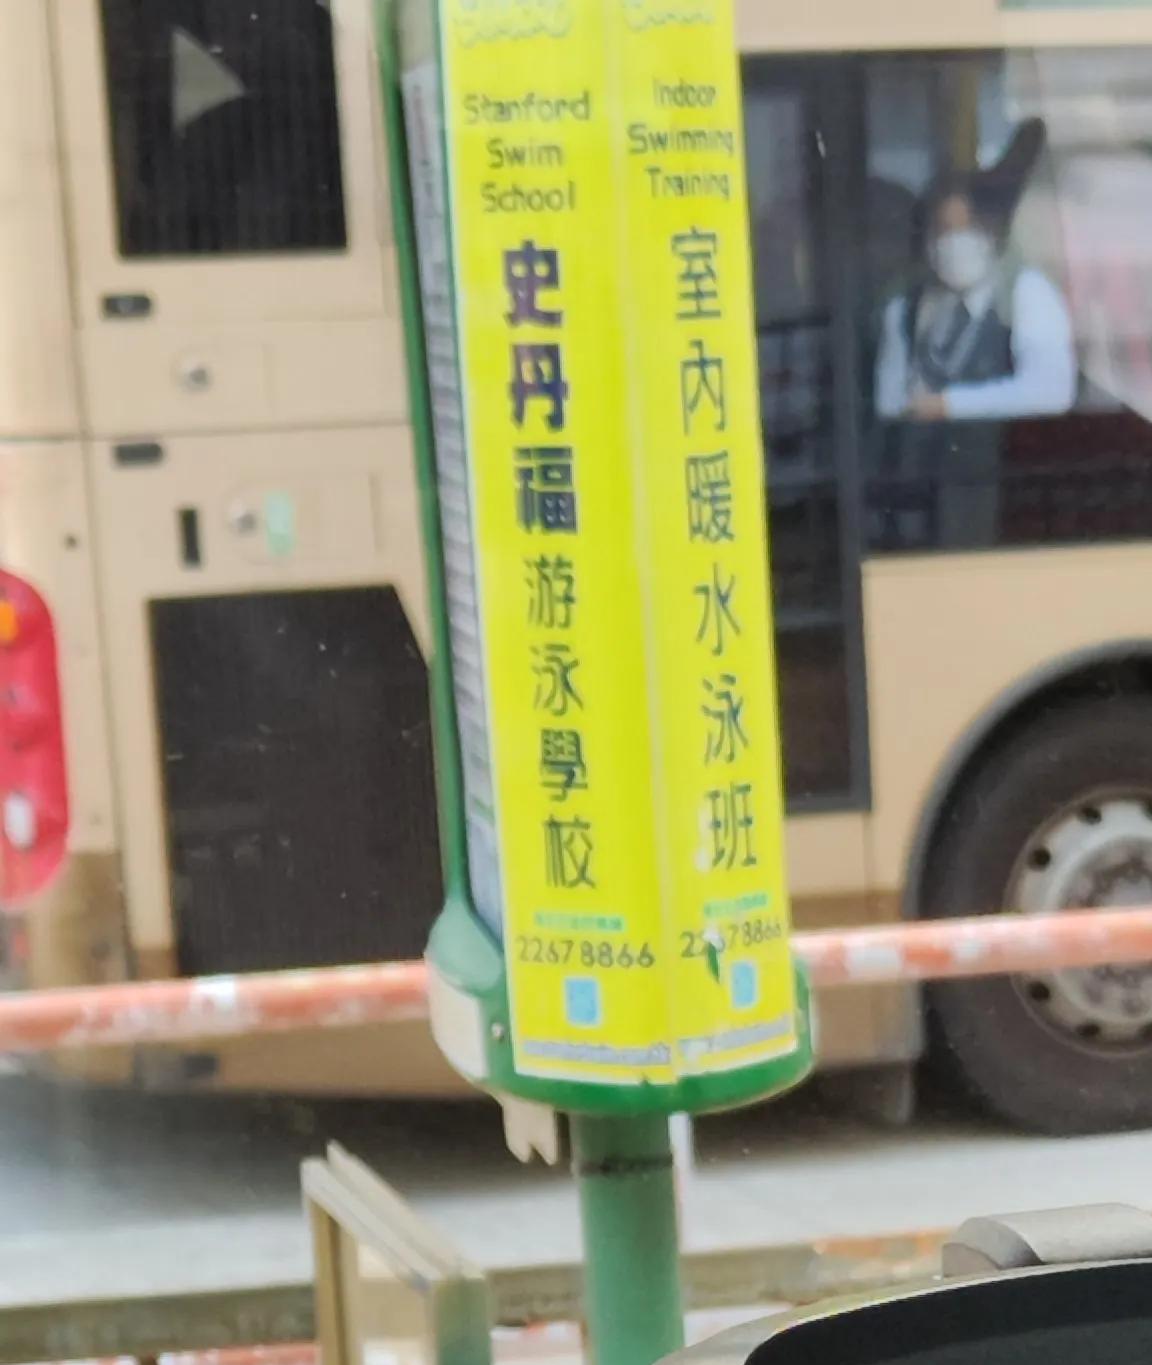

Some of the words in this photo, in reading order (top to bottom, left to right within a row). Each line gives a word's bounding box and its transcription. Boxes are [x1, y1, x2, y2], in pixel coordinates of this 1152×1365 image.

[463, 91, 592, 124] Stanford
[653, 79, 717, 108] Indoor
[486, 137, 565, 169] Swim
[627, 123, 734, 157] Swimming
[480, 180, 577, 213] School
[645, 166, 731, 202] Training
[671, 226, 758, 870] 室內暖水泳班
